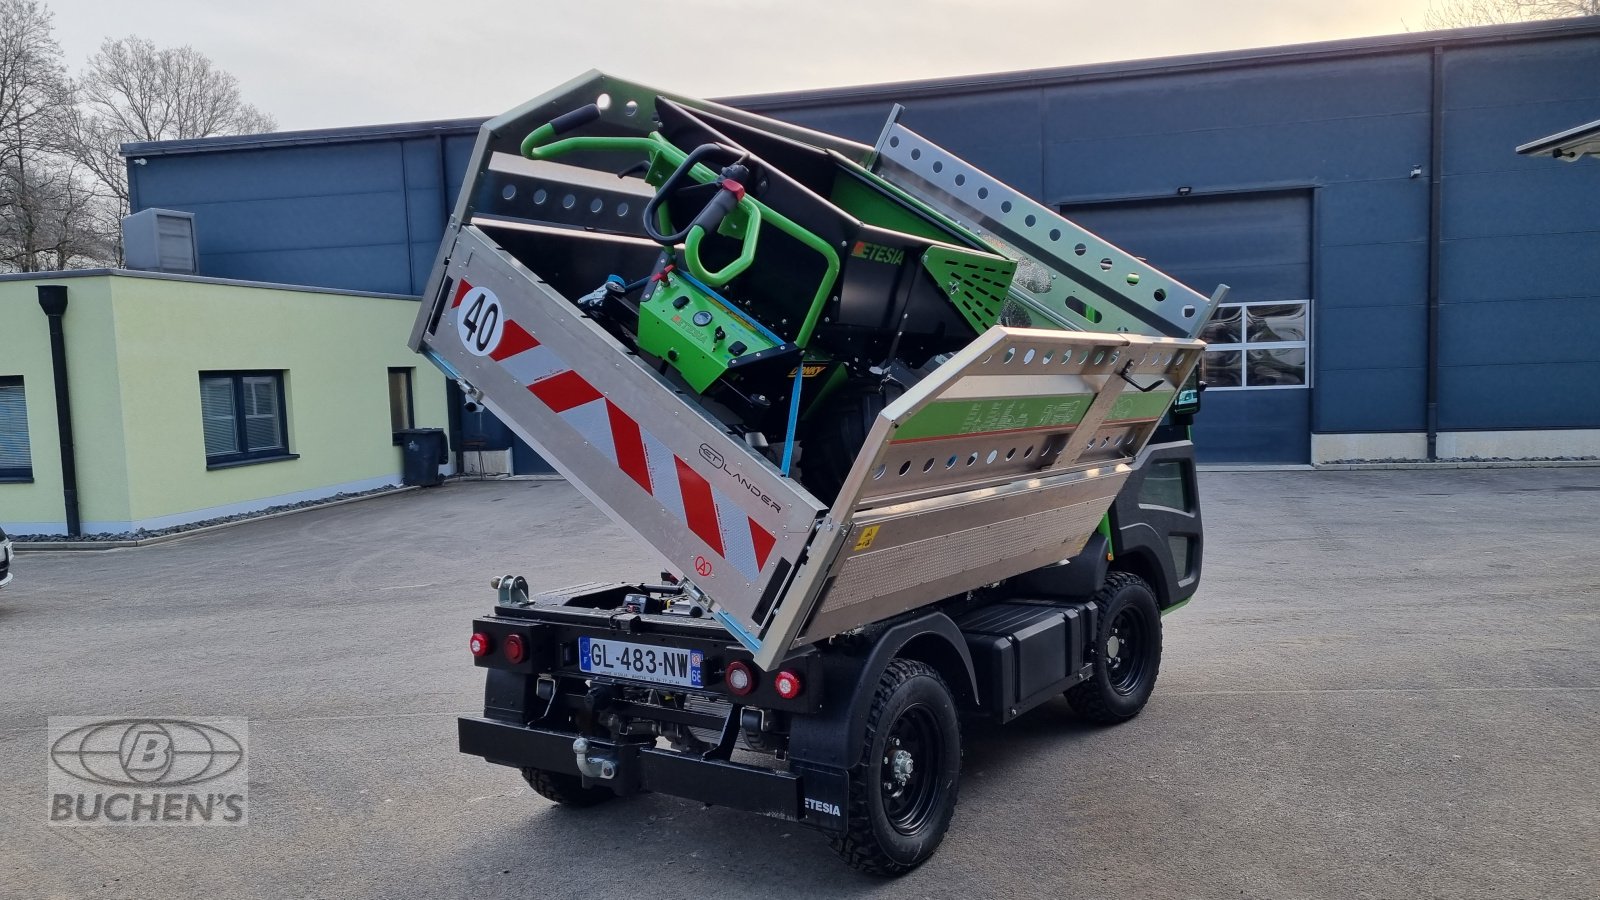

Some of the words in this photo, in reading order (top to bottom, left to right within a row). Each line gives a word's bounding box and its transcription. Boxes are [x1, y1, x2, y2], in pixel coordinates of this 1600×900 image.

[851, 241, 905, 266] ETESIA
[463, 292, 498, 352] 40
[592, 643, 688, 679] GL-483-NW
